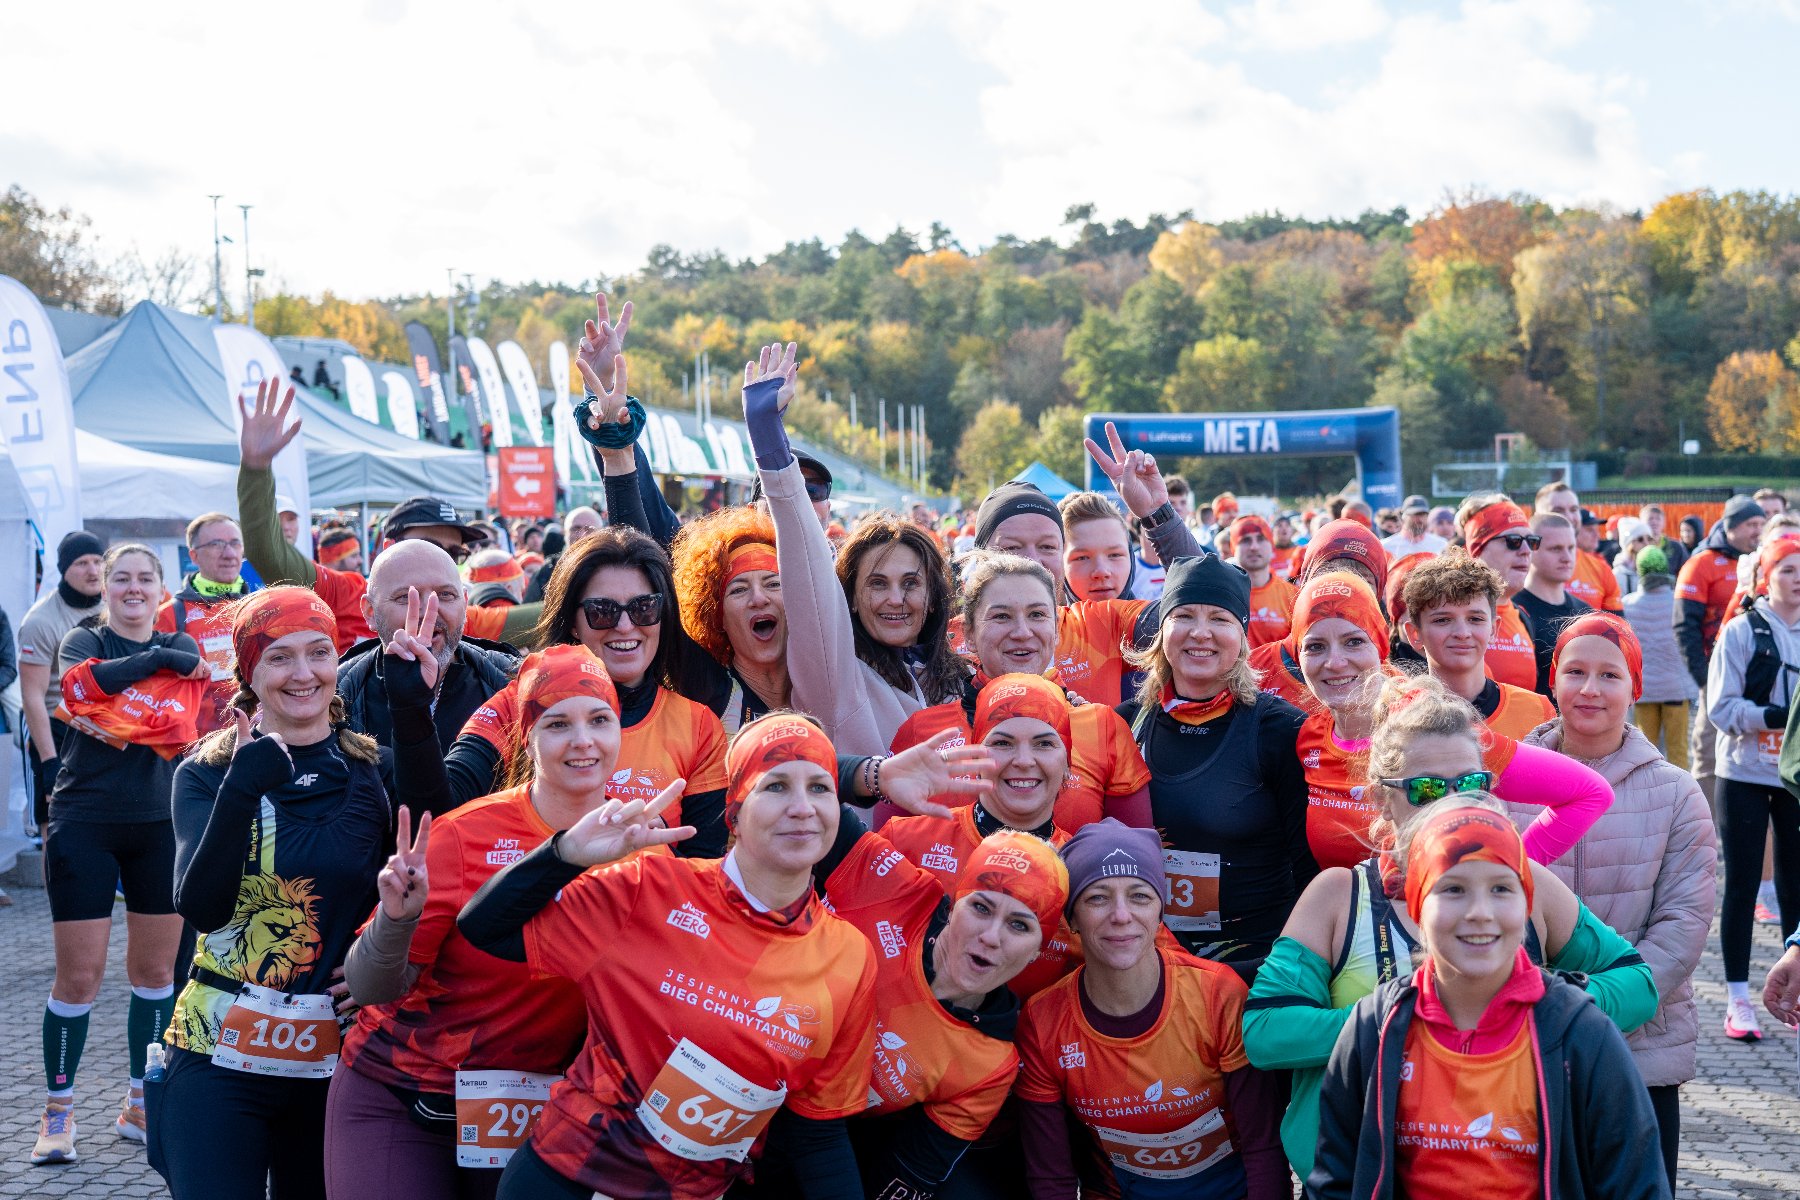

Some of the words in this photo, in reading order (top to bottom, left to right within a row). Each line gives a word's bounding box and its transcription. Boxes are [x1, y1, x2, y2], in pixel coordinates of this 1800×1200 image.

[1204, 420, 1280, 453] META
[1315, 586, 1350, 598] HERO
[990, 687, 1025, 705] HERO
[764, 727, 808, 744] HERO
[1186, 726, 1209, 735] HI-TEC
[295, 774, 318, 786] 4F
[494, 838, 520, 849] JUST
[931, 843, 955, 855] JUST
[998, 847, 1027, 858] JUST
[923, 854, 957, 872] HERO
[987, 854, 1028, 872] HERO
[682, 901, 708, 920] JUST
[670, 910, 711, 937] HERO
[878, 922, 898, 957] HERO
[893, 924, 907, 948] JUST
[1379, 925, 1389, 952] Team
[665, 968, 750, 1008] JESIENNY
[659, 981, 699, 1006] BIEG
[702, 998, 814, 1050] CHARYTATYWNY
[249, 1018, 318, 1053] 106
[766, 1038, 789, 1055] ARTBUD
[680, 1050, 706, 1070] ARTBUD
[1077, 1105, 1103, 1117] BIEG
[1106, 1088, 1211, 1118] CHARYTATYWNY
[677, 1094, 757, 1139] 647
[1133, 1141, 1203, 1165] 649
